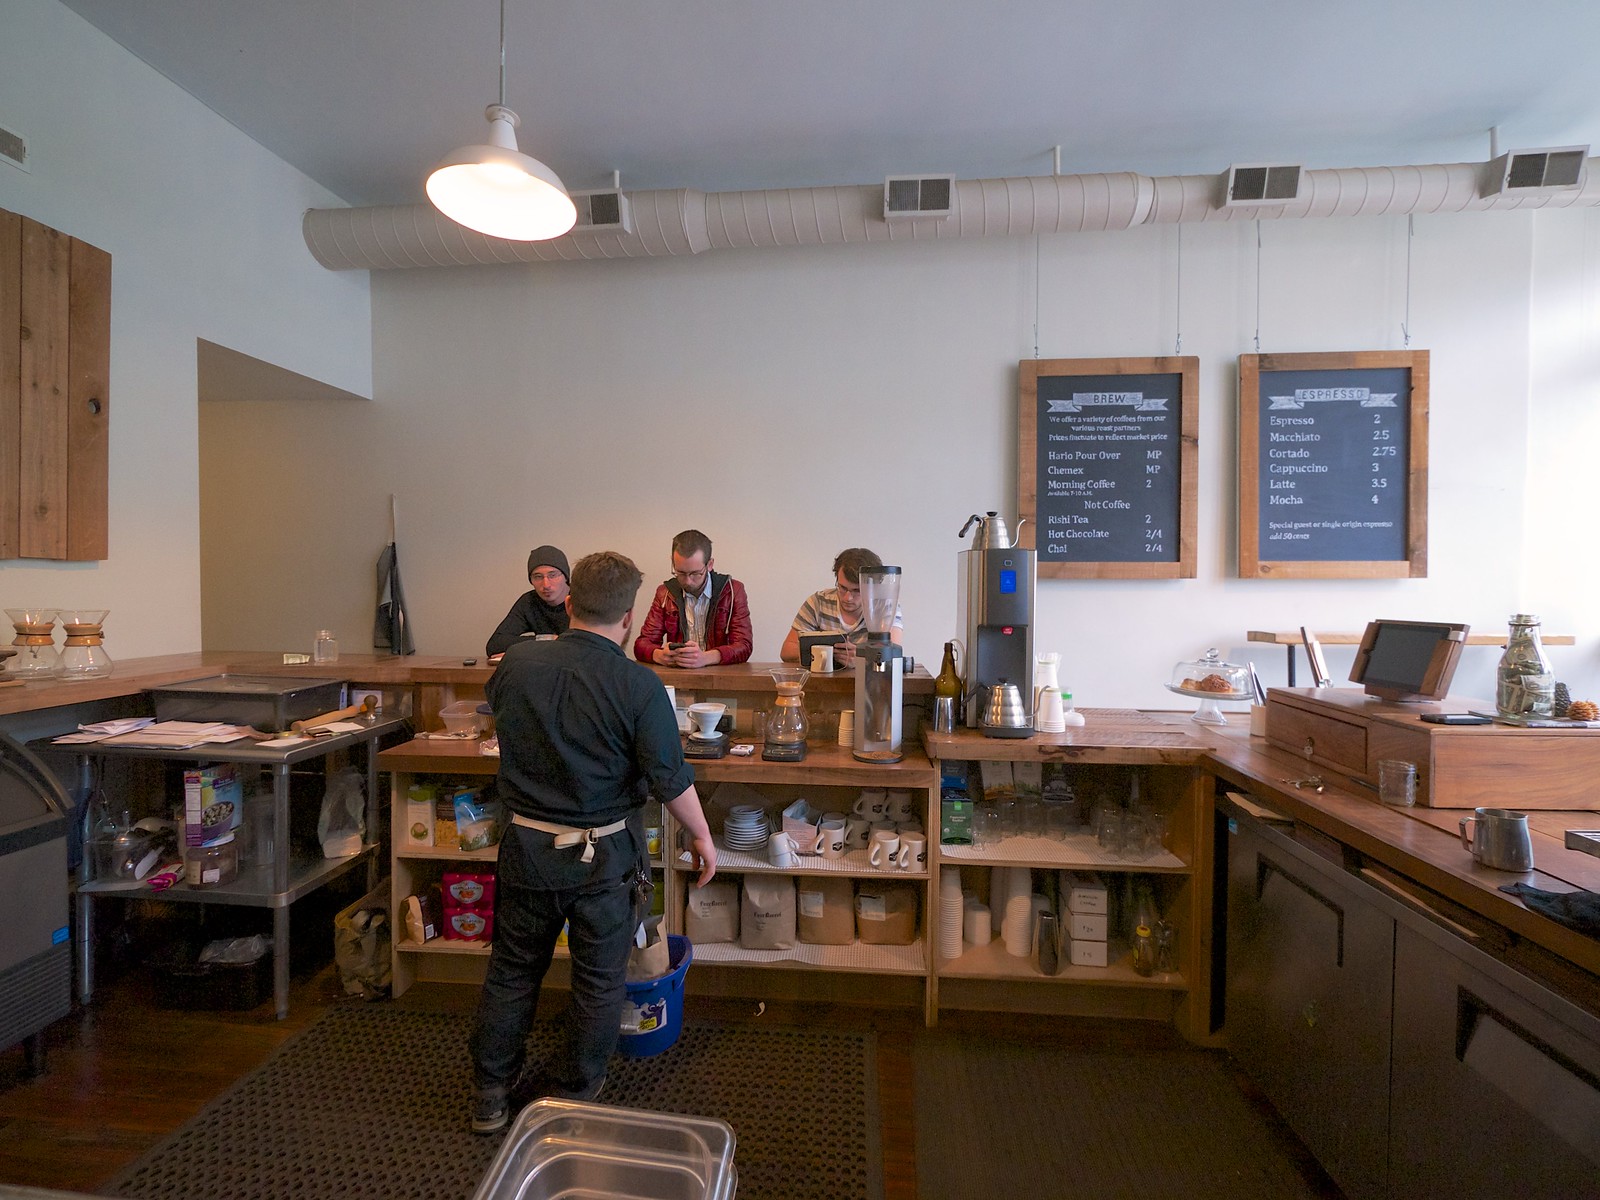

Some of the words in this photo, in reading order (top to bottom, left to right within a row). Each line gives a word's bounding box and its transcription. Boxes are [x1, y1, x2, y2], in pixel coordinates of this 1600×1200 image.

[1093, 394, 1126, 404] BREW
[1301, 389, 1365, 400] ESPRESSO
[1270, 416, 1315, 427] Espresso
[1373, 414, 1381, 424] 2
[1150, 433, 1168, 442] price
[1270, 432, 1321, 442] Macchiato
[1373, 430, 1390, 440] 2.5
[1048, 451, 1073, 460] Hario
[1075, 451, 1097, 460] Pour
[1099, 451, 1121, 460] Over
[1146, 450, 1162, 460] MP
[1269, 448, 1310, 458] Cortado
[1372, 446, 1397, 457] 2.75
[1047, 466, 1084, 475] Chemex
[1146, 464, 1161, 474] MP
[1269, 463, 1328, 475] Cappuccino
[1371, 462, 1379, 472] 3
[1047, 480, 1086, 490] Morning
[1087, 479, 1116, 489] Coffee
[1145, 479, 1152, 489] 2
[1269, 480, 1296, 489] Latte
[1371, 478, 1388, 488] 3.5
[1084, 500, 1101, 510] Not
[1102, 500, 1131, 510] Coffee
[1269, 495, 1303, 505] Mocha
[1371, 494, 1379, 504] 4
[1048, 515, 1070, 524] Rishi
[1071, 515, 1089, 524] Tea
[1145, 514, 1152, 524] 2
[1269, 521, 1293, 530] Special
[1293, 522, 1312, 530] guest
[1321, 521, 1341, 529] single
[1341, 520, 1362, 529] origin
[1048, 529, 1065, 539] Hot
[1065, 529, 1110, 538] Chocolate
[1145, 529, 1162, 540] 2/4
[1269, 532, 1283, 540] add
[1282, 532, 1293, 540] 50
[1047, 544, 1068, 554] Chai
[1145, 543, 1162, 553] 2/4
